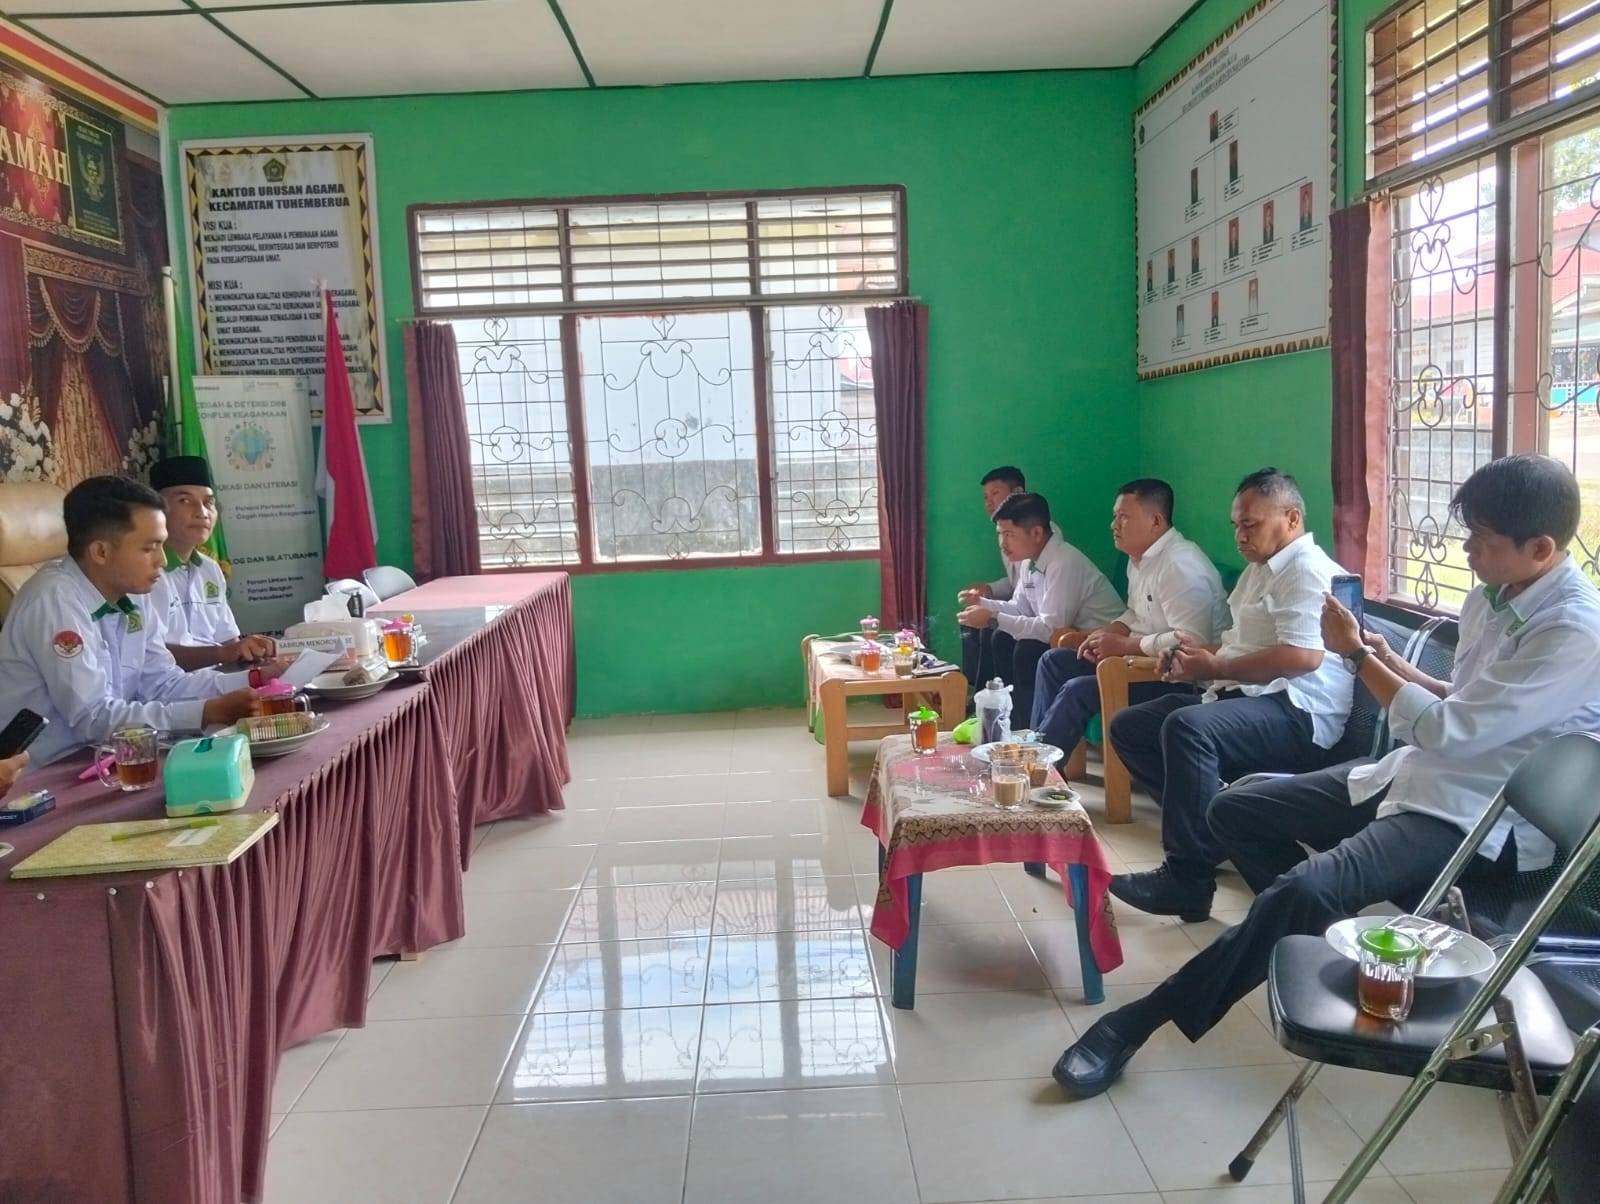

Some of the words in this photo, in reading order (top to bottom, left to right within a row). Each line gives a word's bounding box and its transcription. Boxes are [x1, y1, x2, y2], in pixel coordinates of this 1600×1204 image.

[212, 186, 256, 198] KANTOR
[258, 185, 303, 197] URUSAN
[305, 183, 345, 195] AGAMA
[208, 199, 274, 212] KECAMATAN
[277, 196, 350, 209] TUHEMBERUA
[203, 221, 217, 231] VISI
[218, 220, 233, 230] KUA
[252, 232, 282, 240] PELAYANAN
[288, 230, 319, 238] PEMBINAAN
[319, 229, 339, 237] AGAMA
[295, 242, 306, 250] DAN
[207, 280, 222, 290] MISI
[223, 280, 239, 289] KUA
[214, 293, 255, 301] MENINGKATKAN
[255, 291, 281, 300] KUALITAS
[214, 303, 256, 312] MENINGKATKAN
[256, 302, 282, 311] KUALITAS
[239, 314, 269, 322] PEMBINAAN
[217, 336, 258, 345] MENINGKATKAN
[259, 335, 285, 344] KUALITAS
[218, 347, 259, 356] MENINGKATKAN
[260, 346, 286, 355] KUALITAS
[232, 410, 288, 418] KEAGAMAAN
[243, 482, 262, 490] DAN
[262, 480, 299, 489] LITERASI
[246, 556, 265, 564] DAN
